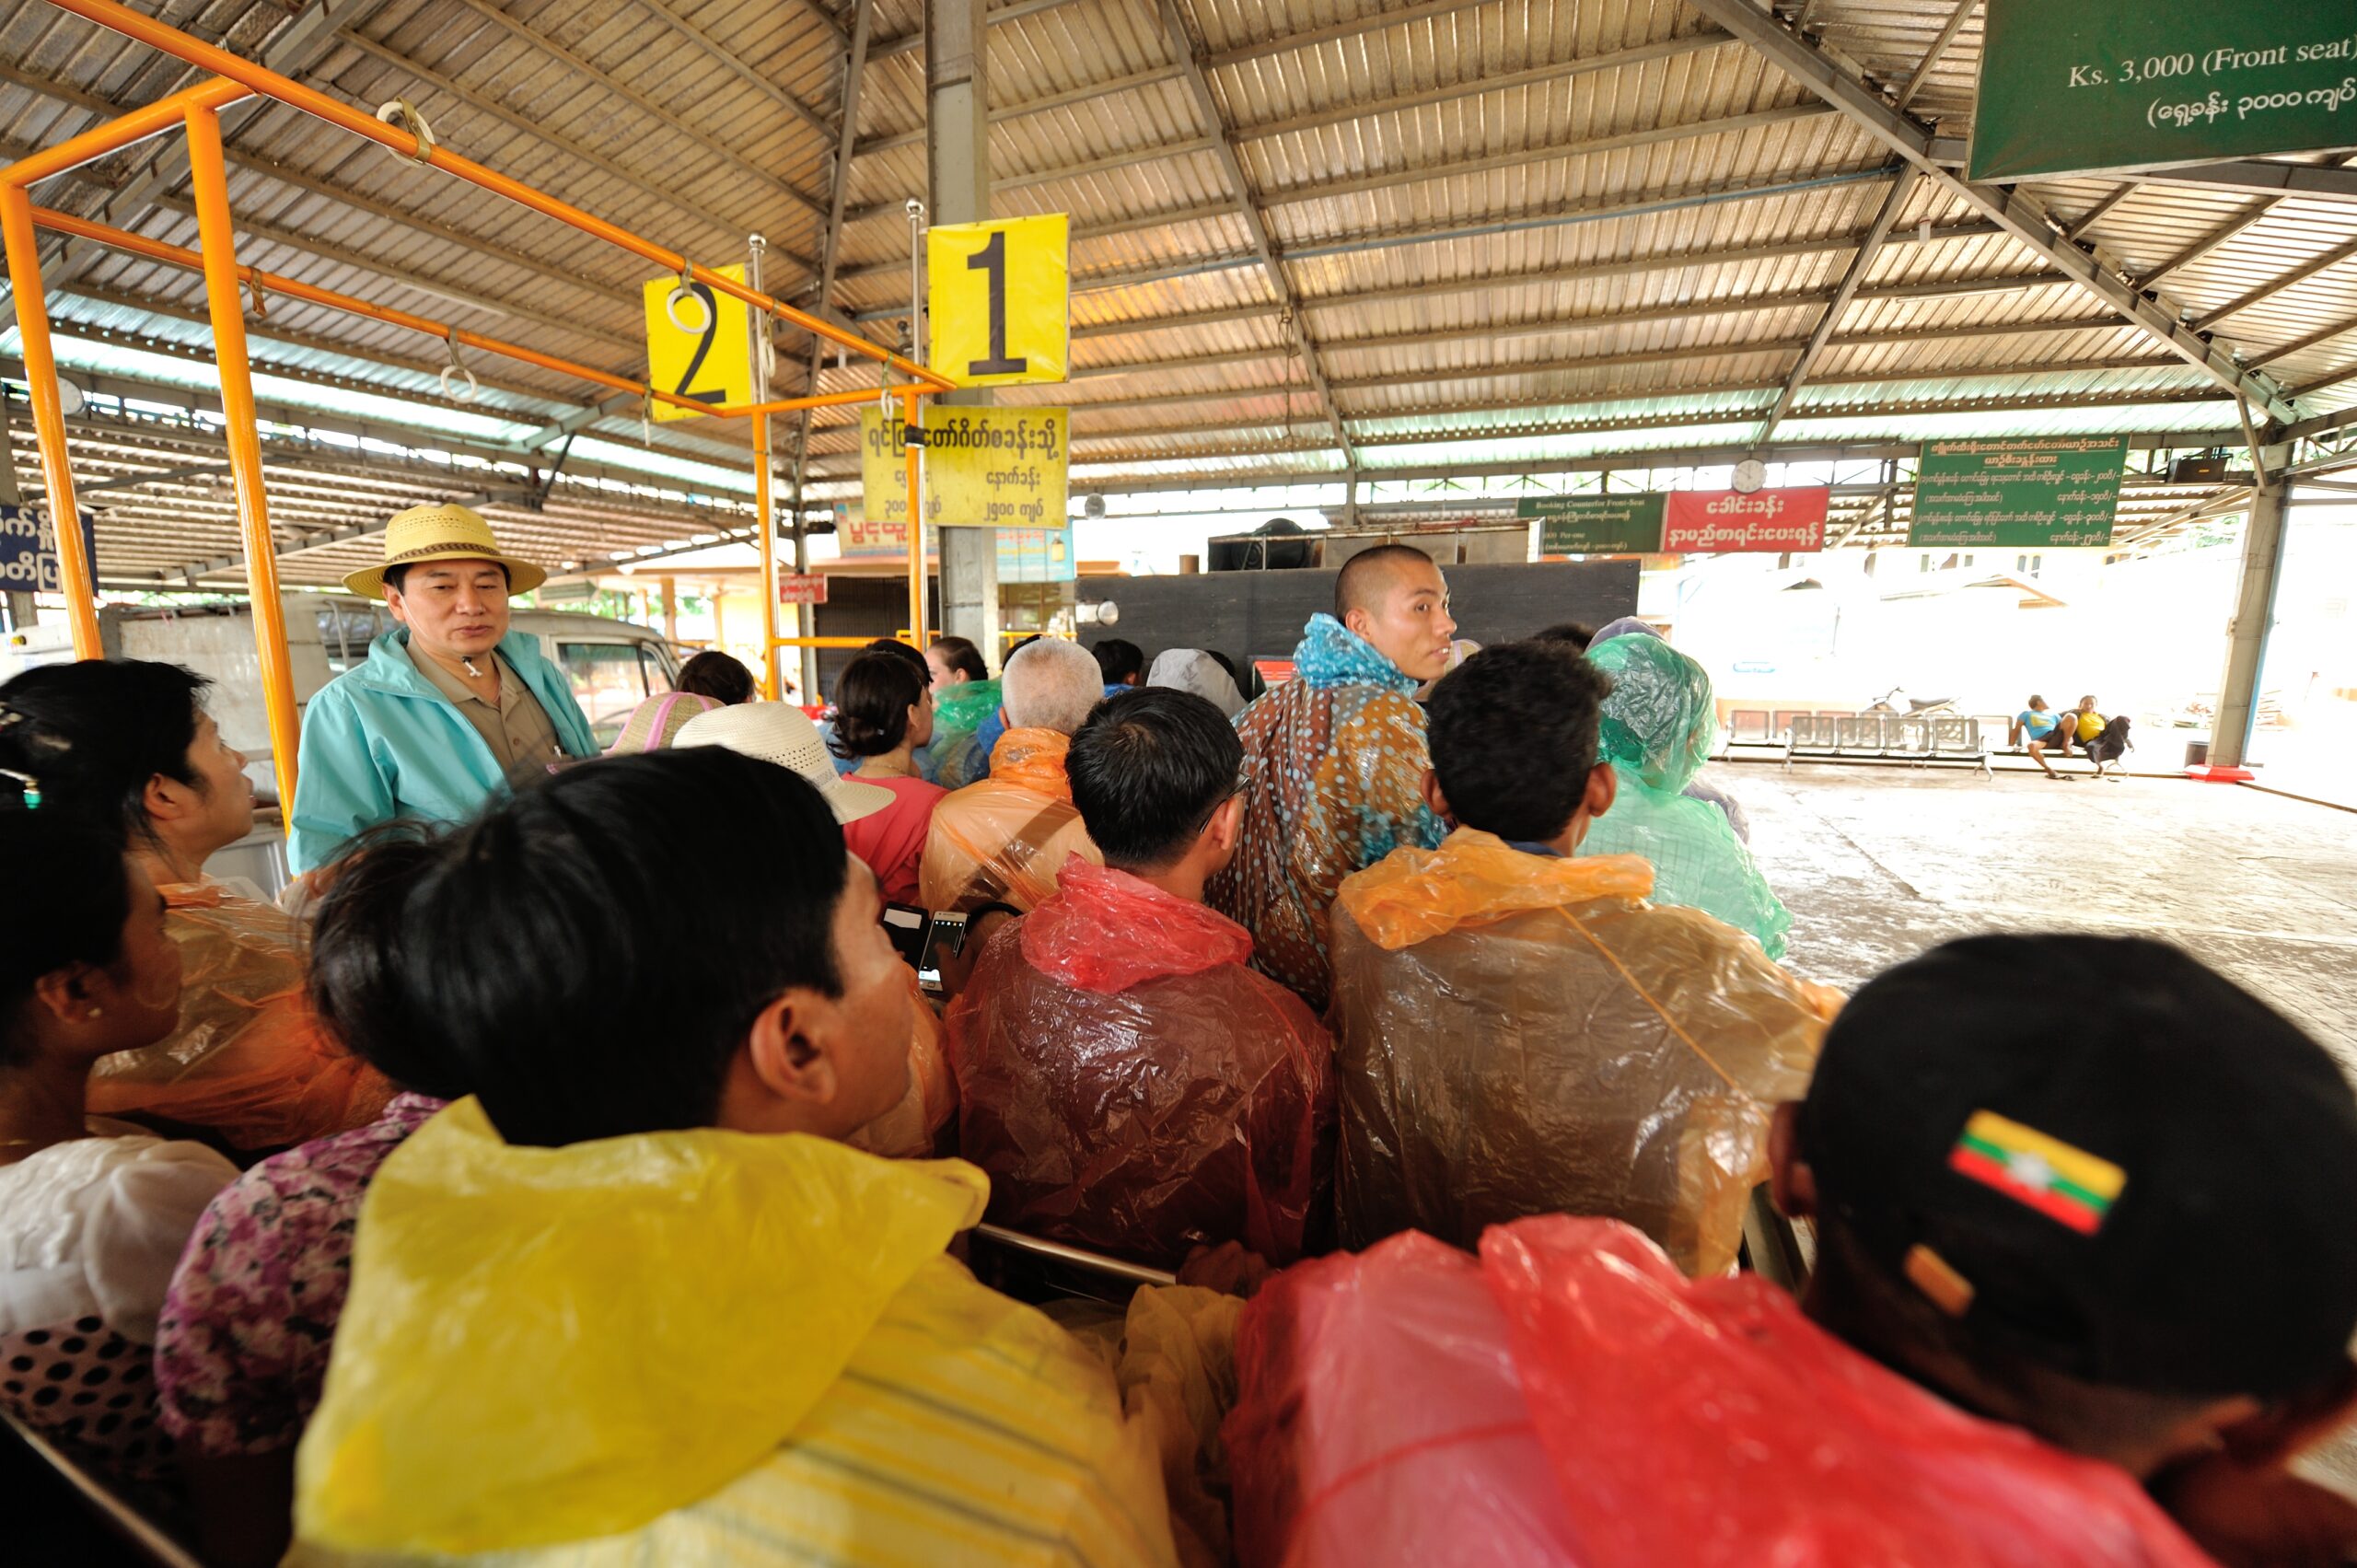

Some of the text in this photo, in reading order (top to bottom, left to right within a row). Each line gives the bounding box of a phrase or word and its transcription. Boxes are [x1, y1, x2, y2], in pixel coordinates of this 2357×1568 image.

[2067, 65, 2108, 88] Ks.
[2119, 53, 2194, 84] 3,000
[2202, 45, 2288, 75] (Front
[669, 282, 726, 409] 2
[967, 231, 1027, 376] 1
[1536, 501, 1565, 510] Booking
